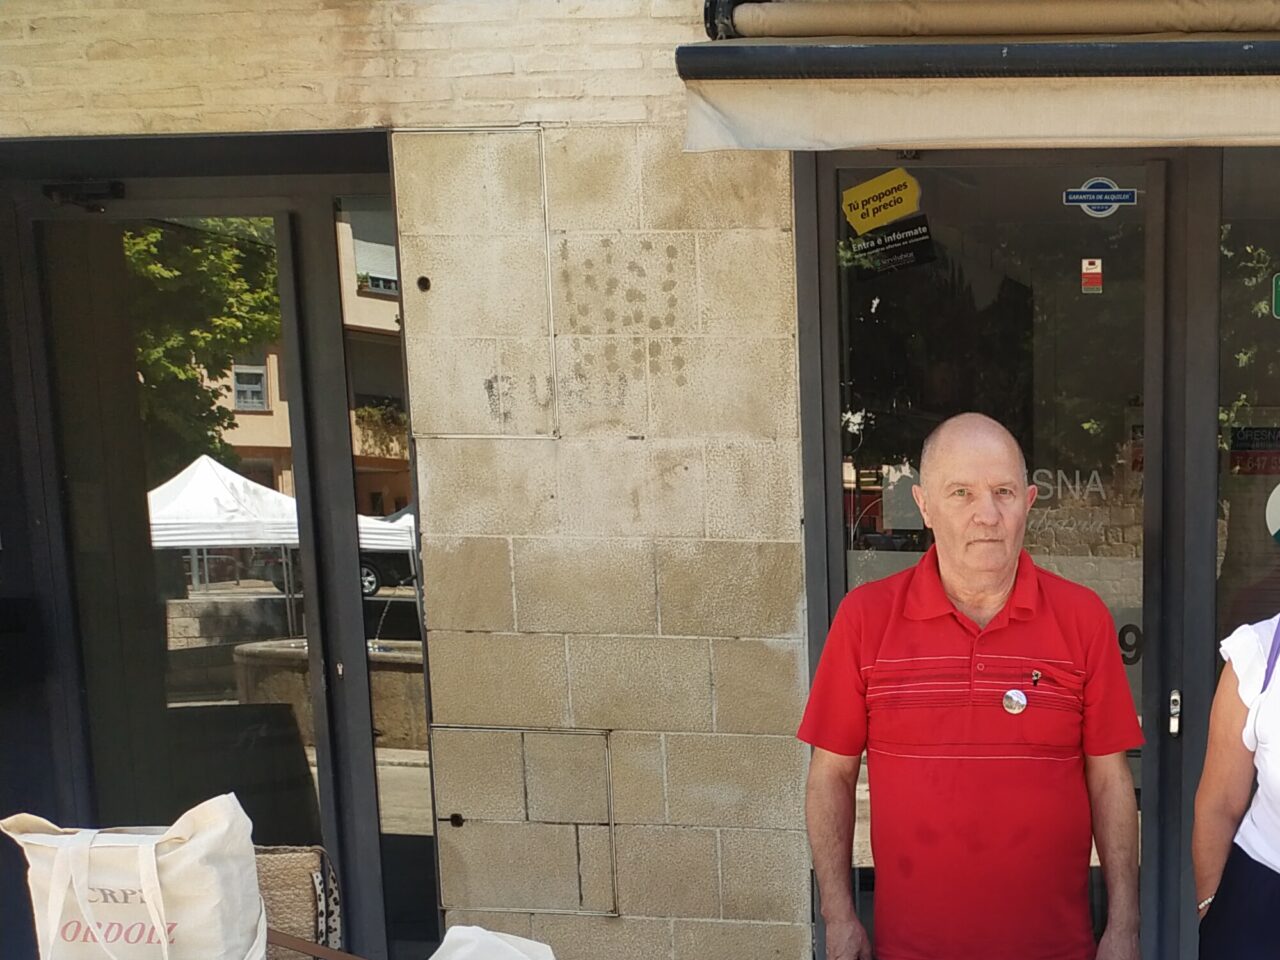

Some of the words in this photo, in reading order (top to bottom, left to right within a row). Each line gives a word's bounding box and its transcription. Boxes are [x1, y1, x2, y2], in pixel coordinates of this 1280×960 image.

[847, 200, 859, 212] Tú
[861, 182, 909, 208] propones
[860, 208, 870, 219] el
[872, 196, 903, 217] precio
[852, 239, 875, 252] Entra
[876, 237, 883, 245] e
[884, 226, 928, 244] infórmate
[1033, 468, 1107, 500] SNA
[1119, 624, 1143, 666] 9
